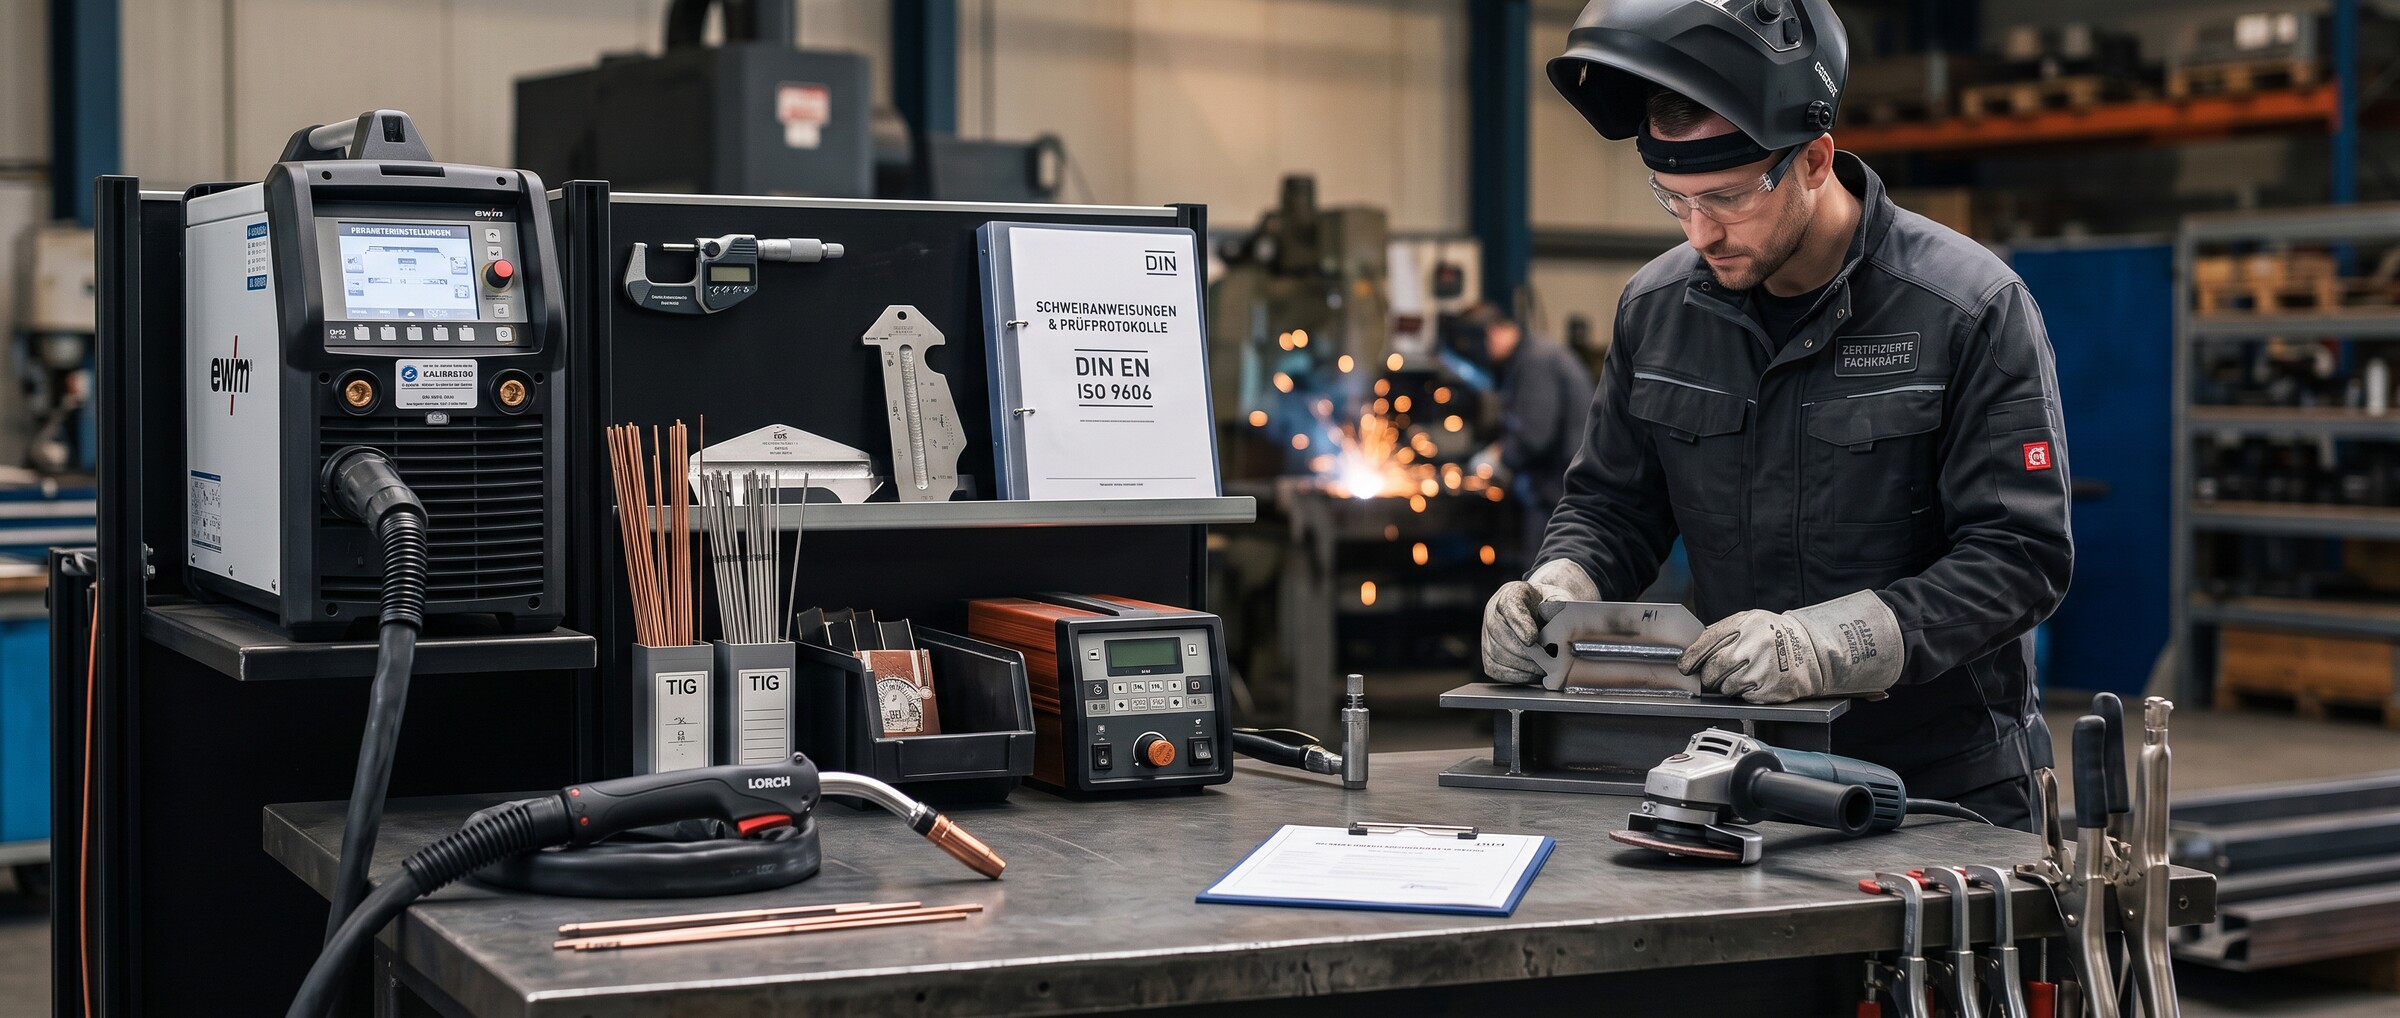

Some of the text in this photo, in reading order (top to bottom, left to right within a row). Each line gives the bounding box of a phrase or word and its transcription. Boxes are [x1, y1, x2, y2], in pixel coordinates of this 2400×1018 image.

[1145, 255, 1177, 271] DIN
[1036, 301, 1177, 317] SCHWEIRANWEISUNGEN
[1048, 317, 1168, 333] & PRÜFPROTOKOLLE
[1842, 341, 1914, 355] ZERTIFIZIERTE
[1075, 356, 1150, 377] DIN EN
[210, 357, 250, 393] ewm
[1077, 383, 1152, 400] ISO 9606
[666, 678, 697, 695] TIG
[749, 675, 779, 691] TIG
[748, 776, 791, 789] LORCH
